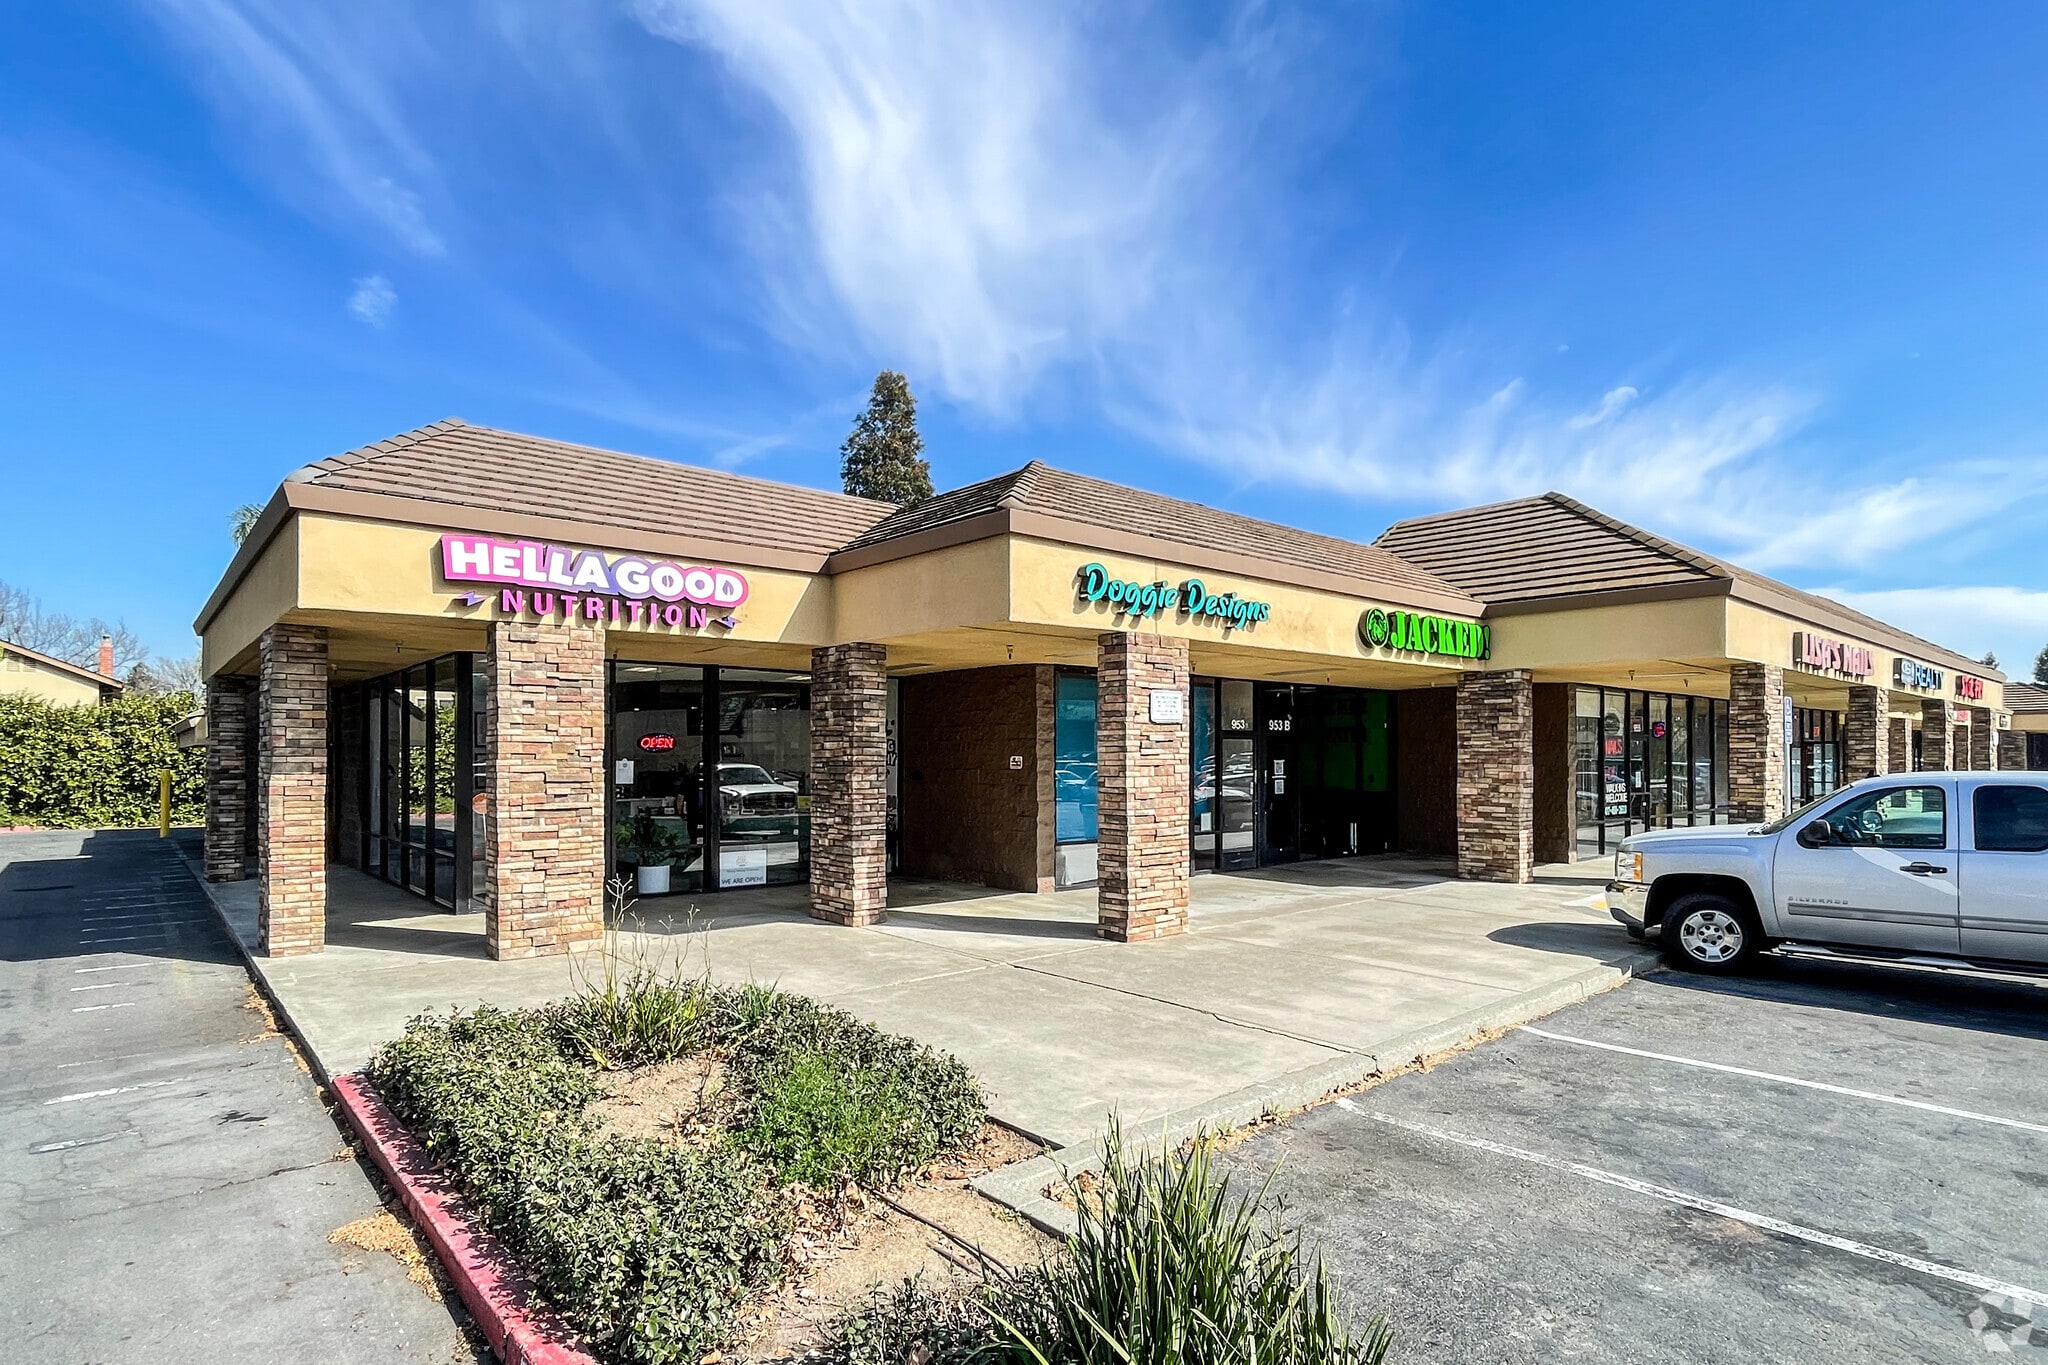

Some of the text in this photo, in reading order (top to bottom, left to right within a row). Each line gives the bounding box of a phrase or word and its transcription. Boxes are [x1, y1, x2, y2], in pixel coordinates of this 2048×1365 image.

[449, 540, 744, 602] HELLA GOOD
[502, 588, 708, 629] NUTRITION
[1085, 562, 1272, 630] Doggie Designs
[1390, 610, 1491, 661] JACKED!
[1802, 632, 1842, 671] LISA'S
[1915, 663, 1944, 690] REALTY
[640, 737, 674, 749] OPEN
[1231, 719, 1245, 730] 953
[1268, 719, 1291, 731] 953 B
